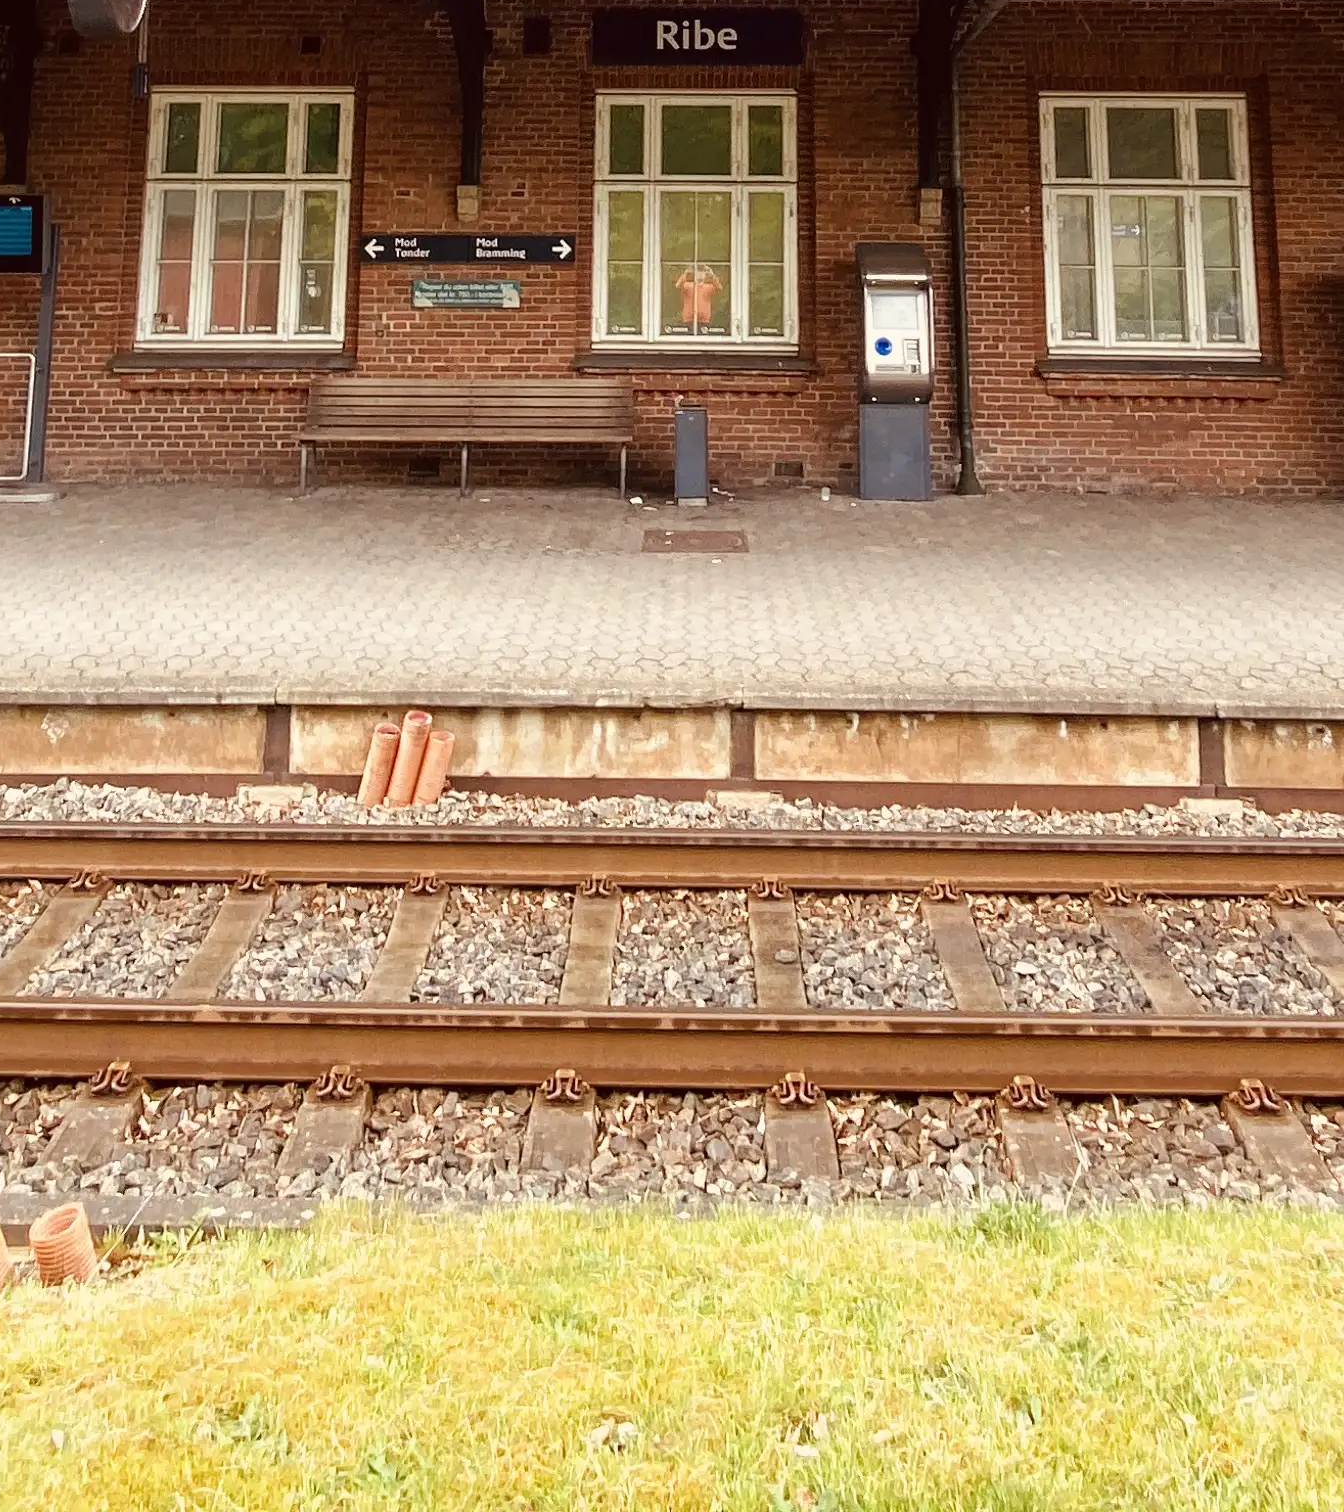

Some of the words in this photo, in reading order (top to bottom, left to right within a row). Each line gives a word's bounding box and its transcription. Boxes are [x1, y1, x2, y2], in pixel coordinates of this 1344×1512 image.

[656, 19, 738, 50] Ribe
[395, 238, 417, 247] Mod
[476, 238, 498, 247] Mod
[476, 248, 526, 259] Bramming
